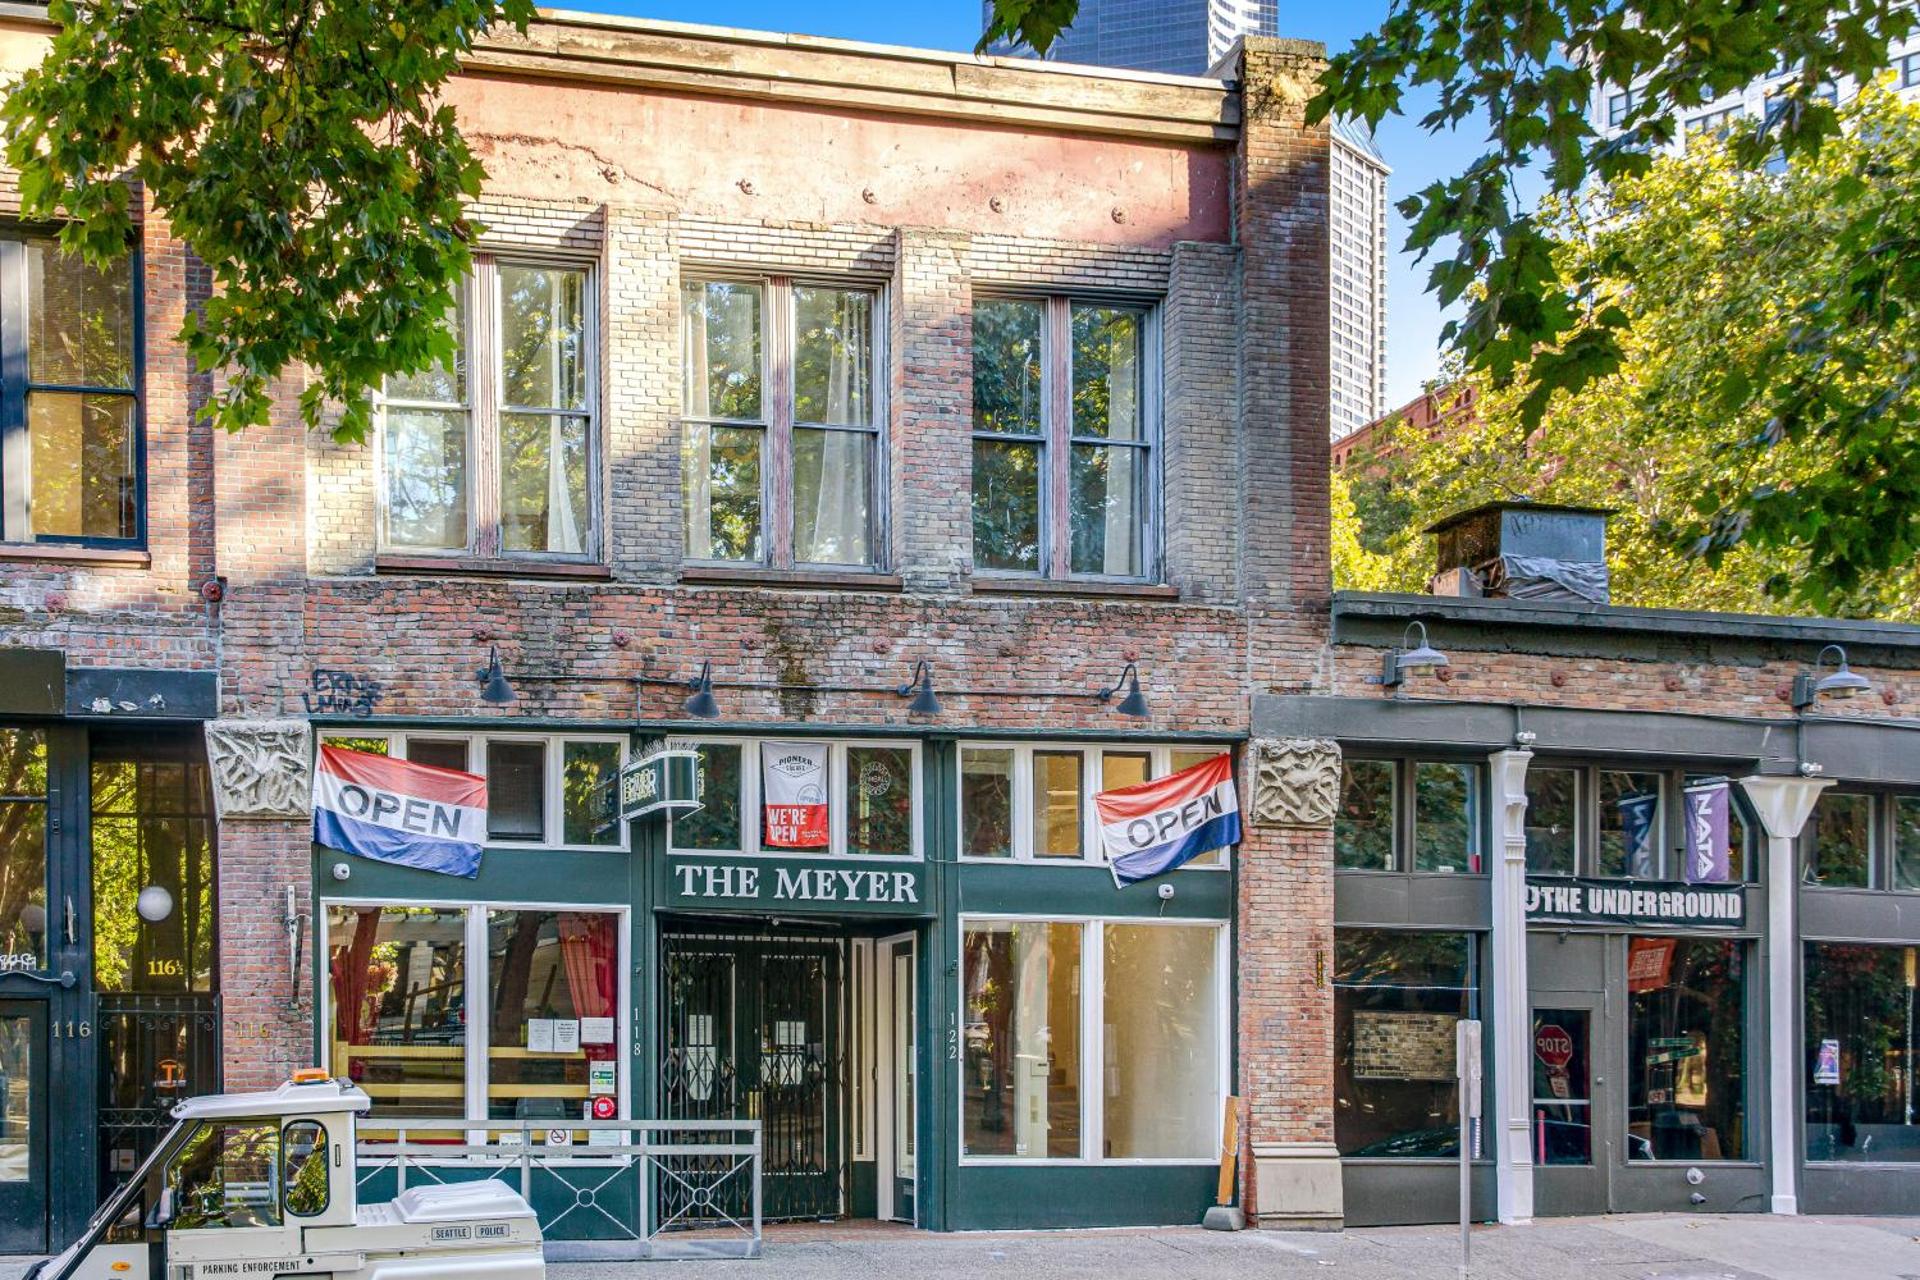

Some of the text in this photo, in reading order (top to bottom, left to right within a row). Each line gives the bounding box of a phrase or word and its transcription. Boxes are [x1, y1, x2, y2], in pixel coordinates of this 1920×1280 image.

[338, 785, 462, 838] OPEN
[768, 808, 808, 825] WE'RE
[1127, 787, 1223, 848] OPEN
[676, 864, 919, 904] THE MEYER
[1540, 886, 1742, 919] THE UNDERGROUND
[51, 1020, 92, 1039] 116
[633, 1007, 641, 1056] 118
[949, 1011, 957, 1060] 122
[435, 1226, 505, 1239] SEATTLE POLICE
[202, 1260, 300, 1275] PARKING ENFORCEMENT
